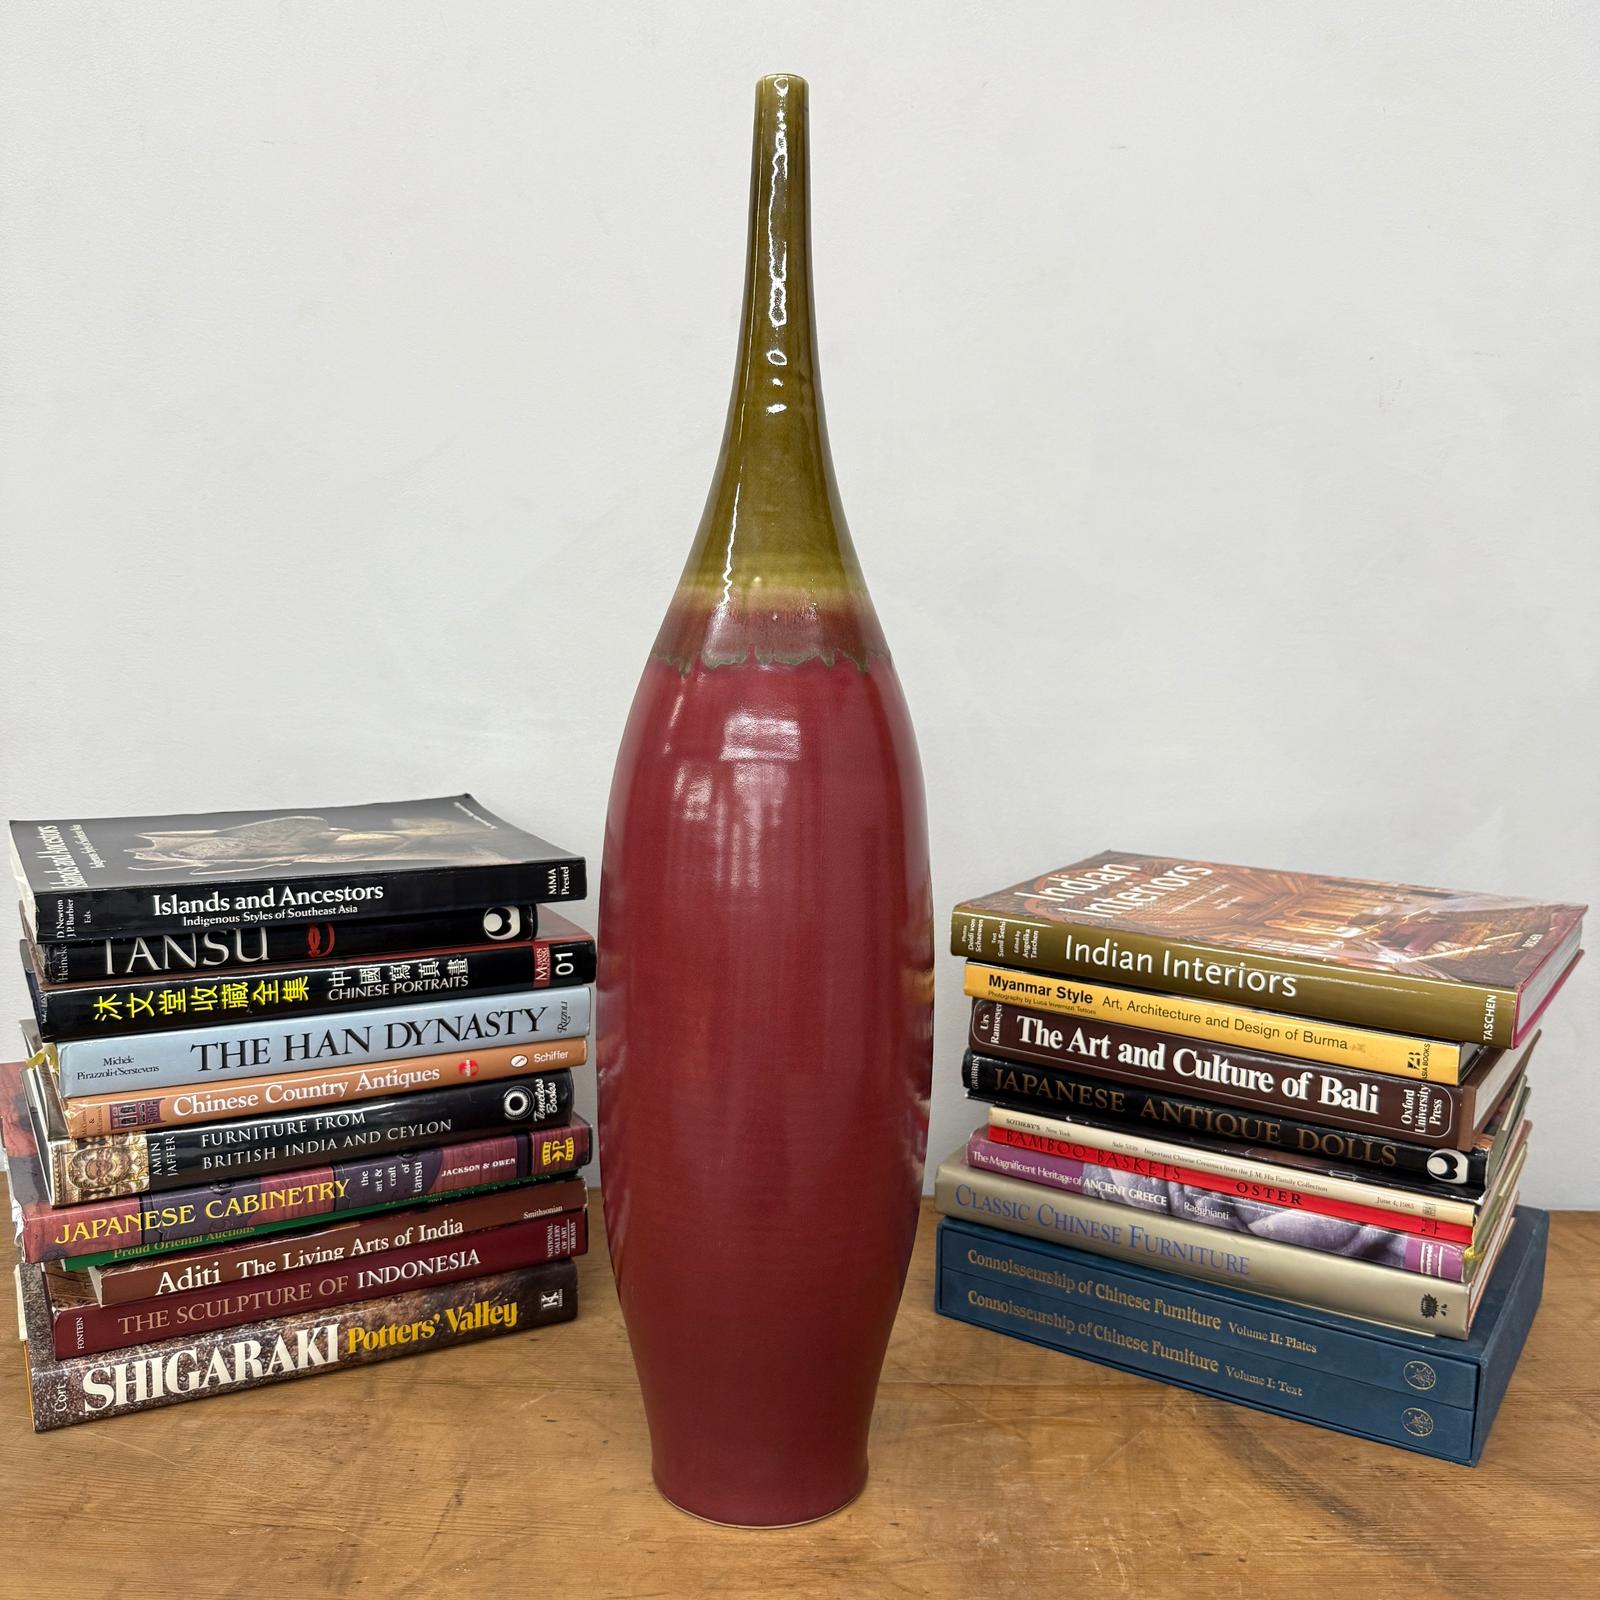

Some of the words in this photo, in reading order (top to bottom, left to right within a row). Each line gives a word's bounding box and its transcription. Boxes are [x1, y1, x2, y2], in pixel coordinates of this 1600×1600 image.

[548, 868, 557, 895] MMA
[561, 866, 570, 896] Prestel
[1014, 862, 1141, 902] Indian
[56, 899, 65, 929] Newton
[66, 899, 75, 925] Barbier
[153, 891, 228, 917] Islands
[235, 886, 275, 910] and
[279, 884, 384, 907] Ancestors
[183, 914, 240, 928] Indigenous
[243, 911, 273, 923] Styles
[275, 908, 287, 920] of
[288, 906, 336, 919] Southeast
[338, 904, 358, 915] Asia
[57, 930, 65, 938] D.
[1022, 929, 1031, 959] Angelika
[555, 952, 574, 976] 01
[1065, 934, 1153, 974] Indian
[1163, 950, 1297, 998] Interiors
[93, 975, 309, 1021] 沐文堂收藏全集
[328, 984, 390, 1001] CHINESE
[393, 975, 469, 994] PORTRAITS
[987, 990, 1024, 1004] Photography
[1024, 996, 1032, 1006] by
[979, 1014, 989, 1030] Urs
[988, 974, 1051, 997] Myanmar
[1056, 986, 1093, 1005] Style
[1102, 996, 1122, 1011] Art,
[1126, 1000, 1201, 1024] Architecture
[1205, 1016, 1229, 1029] and
[1234, 1018, 1280, 1039] Design
[1285, 1029, 1299, 1041] of
[1303, 1030, 1348, 1050] Burma
[990, 1003, 1003, 1044] Ramseyer
[1482, 994, 1497, 1041] TASCHEN
[190, 1037, 271, 1072] THE
[283, 1025, 373, 1062] HAN
[384, 1006, 548, 1050] DYNASTY
[1422, 1043, 1431, 1066] BOOKS
[533, 1050, 569, 1063] Schiffer
[1016, 1015, 1063, 1051] The
[1065, 1027, 1111, 1060] Art
[1117, 1042, 1166, 1071] and
[1172, 1047, 1274, 1094] Culture
[1281, 1071, 1313, 1101] of
[1317, 1074, 1379, 1115] Bali
[173, 1094, 259, 1116] Chinese
[265, 1081, 349, 1104] Country
[355, 1068, 440, 1092] Antiques
[533, 1078, 545, 1122] Timeless
[546, 1082, 558, 1114] Books
[1401, 1089, 1415, 1125] Oxford
[1414, 1084, 1431, 1133] University
[993, 1068, 1126, 1112] JAPANESE
[1140, 1098, 1281, 1144] ANTIQUE
[1296, 1127, 1397, 1167] DOLLS
[1429, 1099, 1443, 1126] Press
[201, 1119, 307, 1148] FURNITURE
[316, 1112, 366, 1131] FROM
[203, 1147, 276, 1170] BRITISH
[285, 1137, 338, 1157] INDIA
[343, 1130, 381, 1148] AND
[387, 1119, 452, 1141] CEYLON
[151, 1142, 162, 1176] AMIN
[166, 1136, 178, 1177] JAFFER
[401, 1163, 410, 1174] of
[441, 1164, 480, 1177] JACKSON
[482, 1162, 490, 1170] &
[492, 1157, 516, 1167] OWEN
[1006, 1130, 1086, 1159] BAMBOO
[1097, 1150, 1182, 1180] BASKETS
[361, 1170, 369, 1186] the
[375, 1168, 383, 1177] &
[389, 1166, 397, 1187] craft
[413, 1161, 423, 1193] tansu
[972, 1150, 988, 1163] The
[989, 1154, 1036, 1176] Magnificent
[1037, 1164, 1073, 1185] Heritage
[1073, 1175, 1083, 1185] of
[1083, 1178, 1127, 1195] ANCIENT
[1128, 1187, 1168, 1206] GREECE
[1297, 1179, 1328, 1193] Collection
[1236, 1181, 1304, 1206] OSTER
[55, 1204, 196, 1244] JAPANESE
[205, 1178, 350, 1219] CABINETRY
[523, 1205, 563, 1220] Smithsonian
[1183, 1201, 1230, 1220] Ragghianti
[113, 1244, 150, 1259] Proud
[153, 1234, 203, 1250] Oriental
[206, 1225, 256, 1241] Auctions
[955, 1183, 1031, 1222] CLASSIC
[1036, 1203, 1122, 1245] CHINESE
[1128, 1223, 1251, 1276] FURNITURE
[155, 1260, 222, 1297] Aditi
[236, 1259, 276, 1279] The
[282, 1246, 345, 1270] Living
[350, 1235, 390, 1257] Arts
[394, 1226, 413, 1247] of
[418, 1218, 464, 1242] India
[118, 1309, 171, 1336] THE
[176, 1282, 313, 1325] SCULPTURE
[319, 1275, 349, 1296] OF
[357, 1248, 481, 1289] INDONESIA
[967, 1249, 1075, 1293] Connoisseurship
[1078, 1280, 1093, 1295] of
[1095, 1283, 1150, 1313] Chinese
[1154, 1298, 1222, 1330] Furniture
[1228, 1321, 1268, 1342] Volume
[1269, 1332, 1283, 1346] II:
[1284, 1335, 1318, 1354] Plates
[76, 1317, 85, 1350] FONTEIN
[967, 1289, 1075, 1335] Connoisseurship
[1078, 1321, 1093, 1337] of
[1093, 1325, 1149, 1353] Chinese
[1151, 1340, 1220, 1373] Furniture
[1225, 1364, 1266, 1387] Volume
[1277, 1380, 1303, 1398] Text
[82, 1323, 340, 1413] SHIGARAKI
[347, 1312, 440, 1354] Potters'
[446, 1299, 518, 1333] Valley
[54, 1384, 67, 1412] Cort
